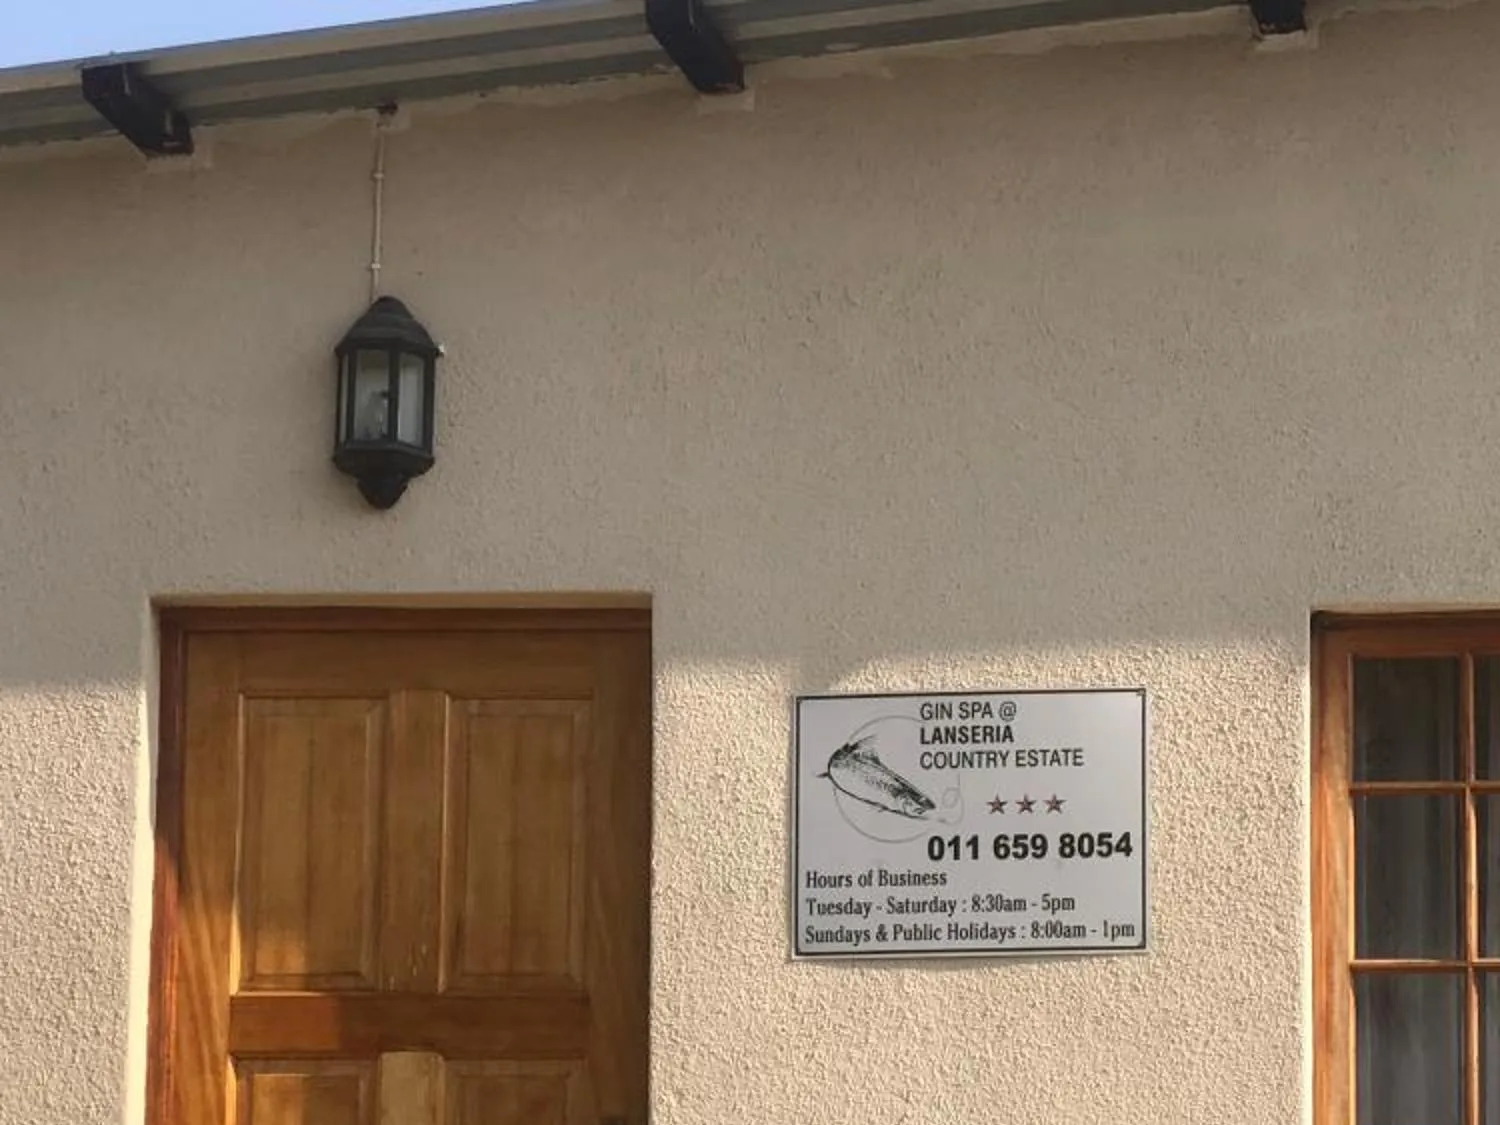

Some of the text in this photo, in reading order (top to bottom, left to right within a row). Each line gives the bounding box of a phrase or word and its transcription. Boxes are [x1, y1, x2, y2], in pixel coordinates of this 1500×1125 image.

[919, 700, 1018, 722] GIN SPA @
[919, 724, 1015, 746] LANSERIA
[919, 748, 1085, 770] COUNTRY ESTATE
[927, 831, 1133, 862] 011 659 8054
[805, 868, 948, 889] Hours of Business
[805, 897, 872, 920] Tuesday
[886, 895, 957, 918] Saturday
[971, 893, 1028, 913] 8:30am
[1041, 892, 1076, 916] 5pm
[804, 924, 871, 947] Sundays
[875, 923, 889, 943] &
[892, 922, 943, 942] Public
[946, 920, 1016, 945] Holidays
[1029, 919, 1087, 940] 8:00am
[1102, 919, 1136, 942] 1pm
